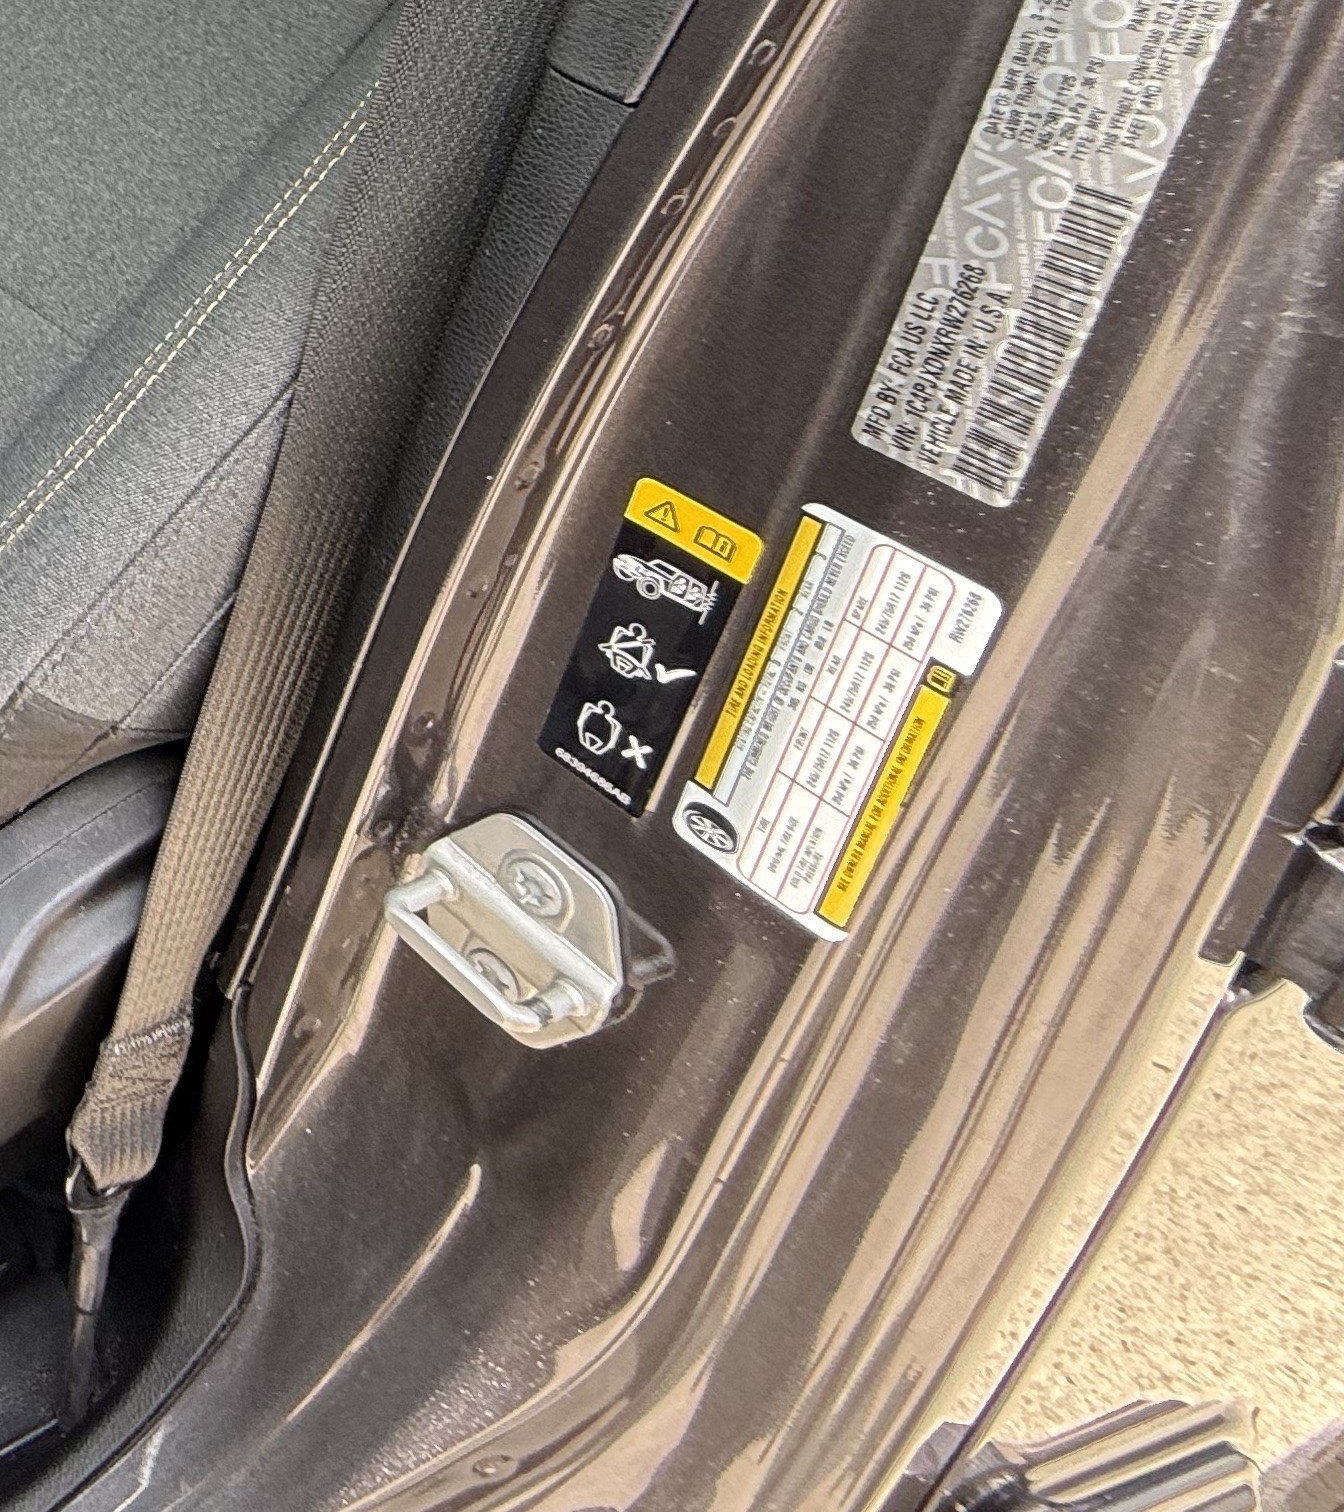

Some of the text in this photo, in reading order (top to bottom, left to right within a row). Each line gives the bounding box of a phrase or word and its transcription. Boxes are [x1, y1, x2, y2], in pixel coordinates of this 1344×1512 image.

[1098, 131, 1119, 155] THIS
[1109, 88, 1137, 130] VEHICLE
[1129, 29, 1162, 85] CONFORMS
[1153, 11, 1171, 26] TO
[1122, 111, 1149, 148] SAFETY
[1139, 84, 1161, 108] AND
[1151, 49, 1176, 81] THEFT
[901, 320, 925, 345] US
[911, 291, 937, 321] LLC
[889, 344, 914, 376] FCA
[891, 264, 982, 452] VIN: 1C4PJXDNXRW276268
[863, 404, 889, 439] MFD
[920, 405, 956, 465] VEHICLE
[945, 358, 977, 404] MADE
[726, 589, 786, 717] TIRE AND LOADING INFORMATION
